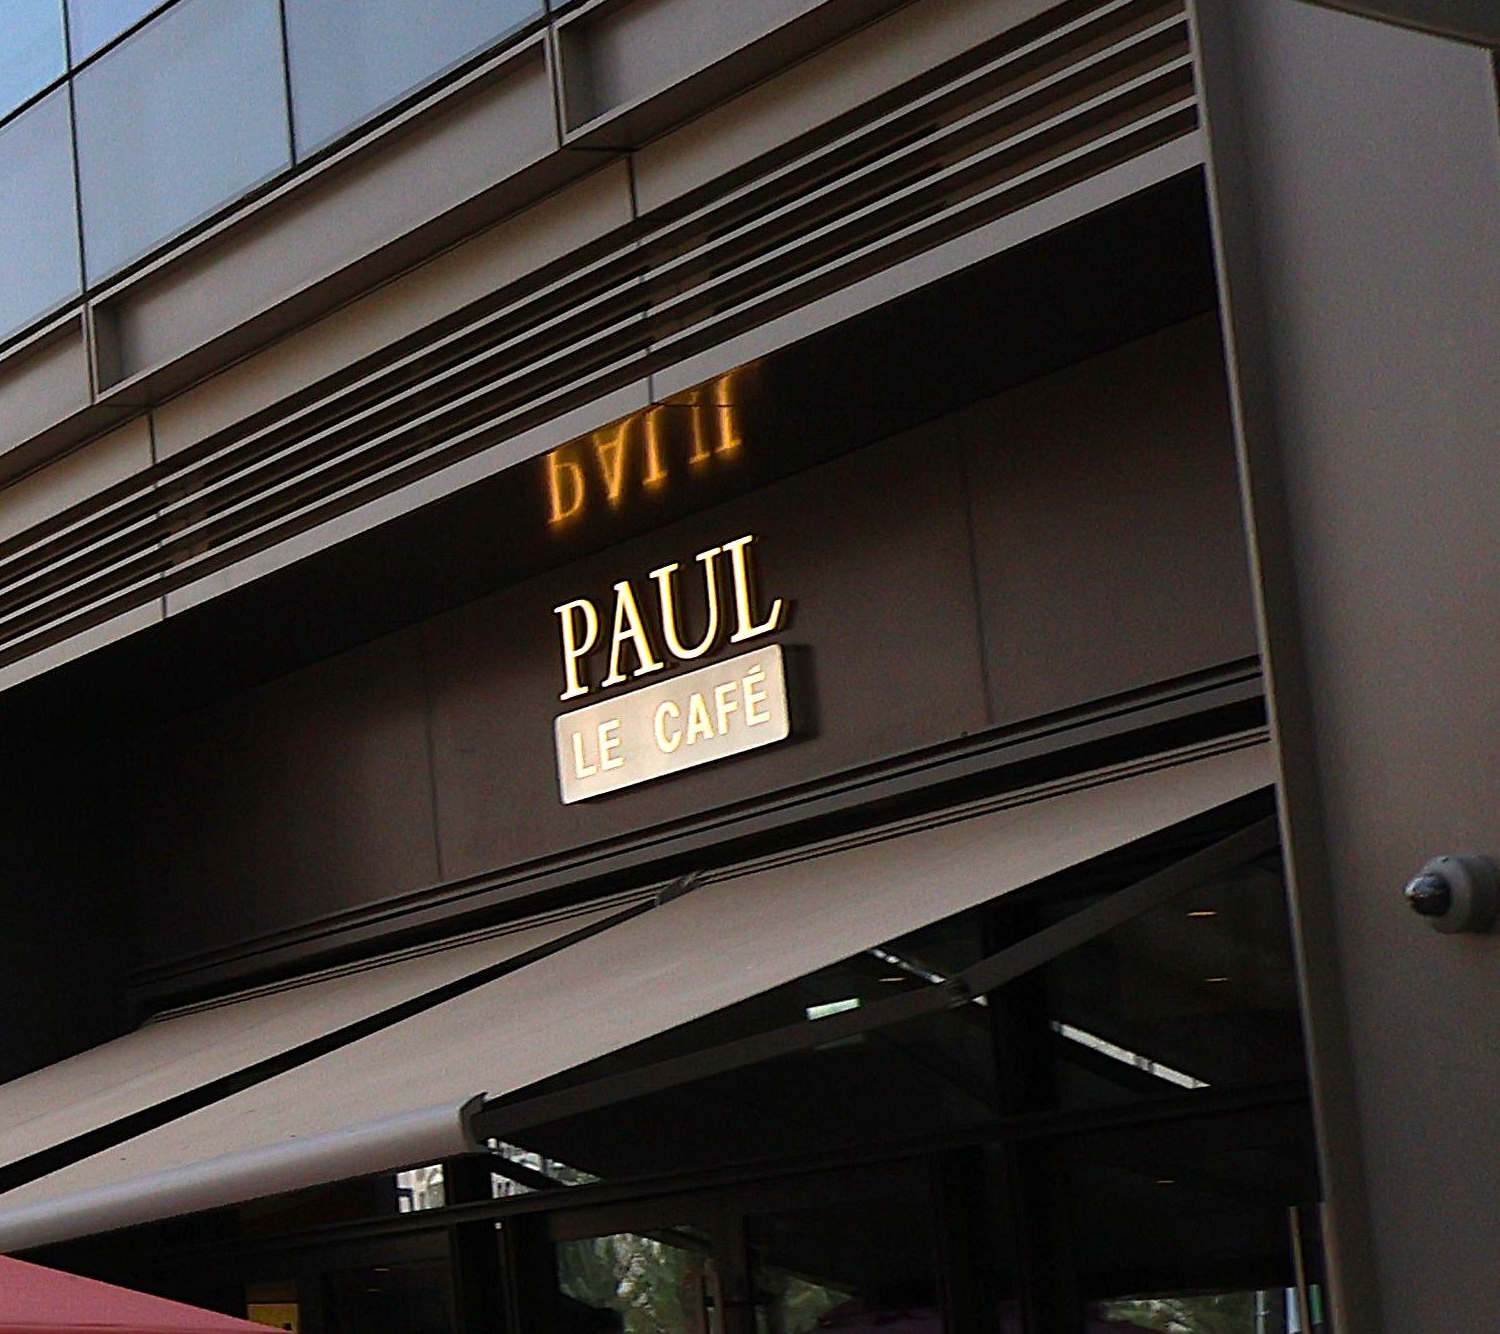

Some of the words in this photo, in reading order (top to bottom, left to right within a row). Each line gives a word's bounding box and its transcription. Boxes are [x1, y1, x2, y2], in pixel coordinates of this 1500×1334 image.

[554, 534, 783, 701] PAUL
[572, 718, 624, 780] LE
[654, 664, 771, 754] CAFÉ
